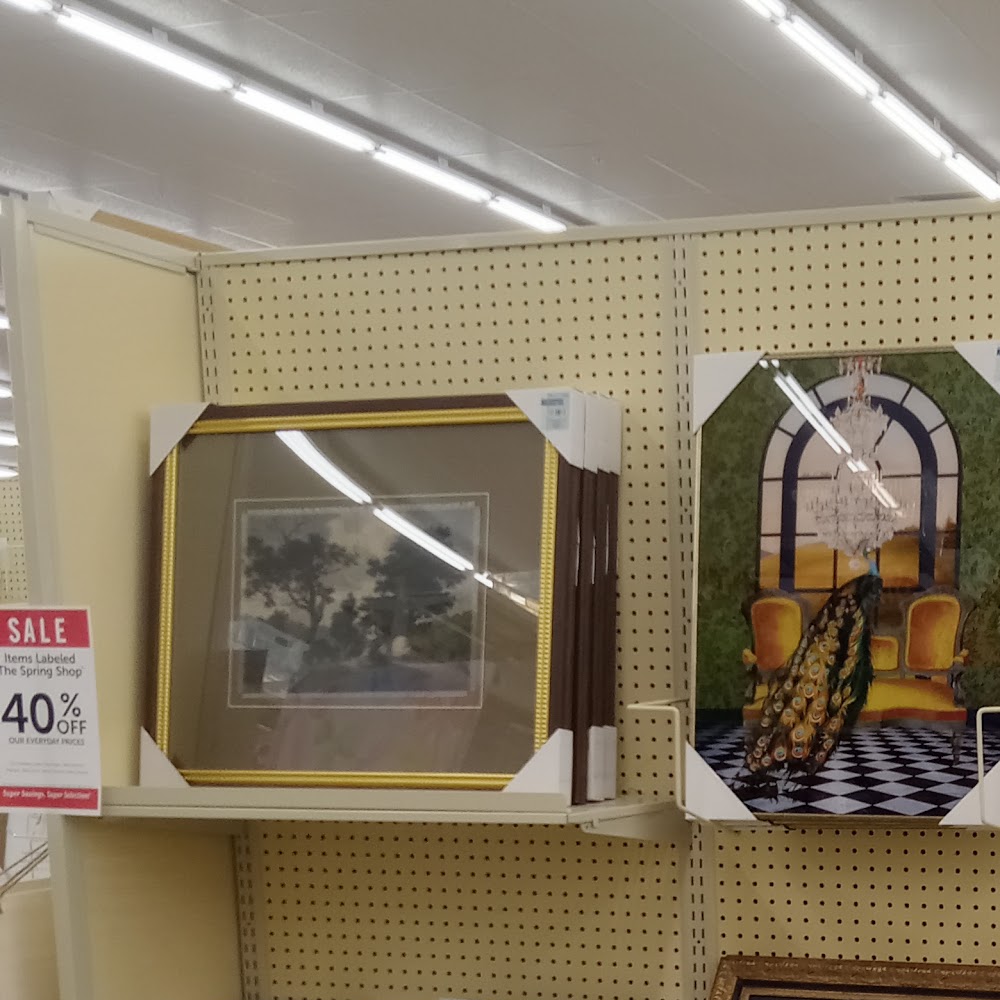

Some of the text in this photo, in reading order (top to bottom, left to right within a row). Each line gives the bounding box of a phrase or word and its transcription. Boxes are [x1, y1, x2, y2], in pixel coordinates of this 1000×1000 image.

[8, 617, 67, 644] SALE
[4, 653, 76, 664] Items Labeled
[20, 665, 53, 679] Spring
[56, 666, 82, 679] Shop
[57, 720, 87, 734] OFF
[8, 737, 25, 745] OUR
[61, 738, 85, 746] PRICES
